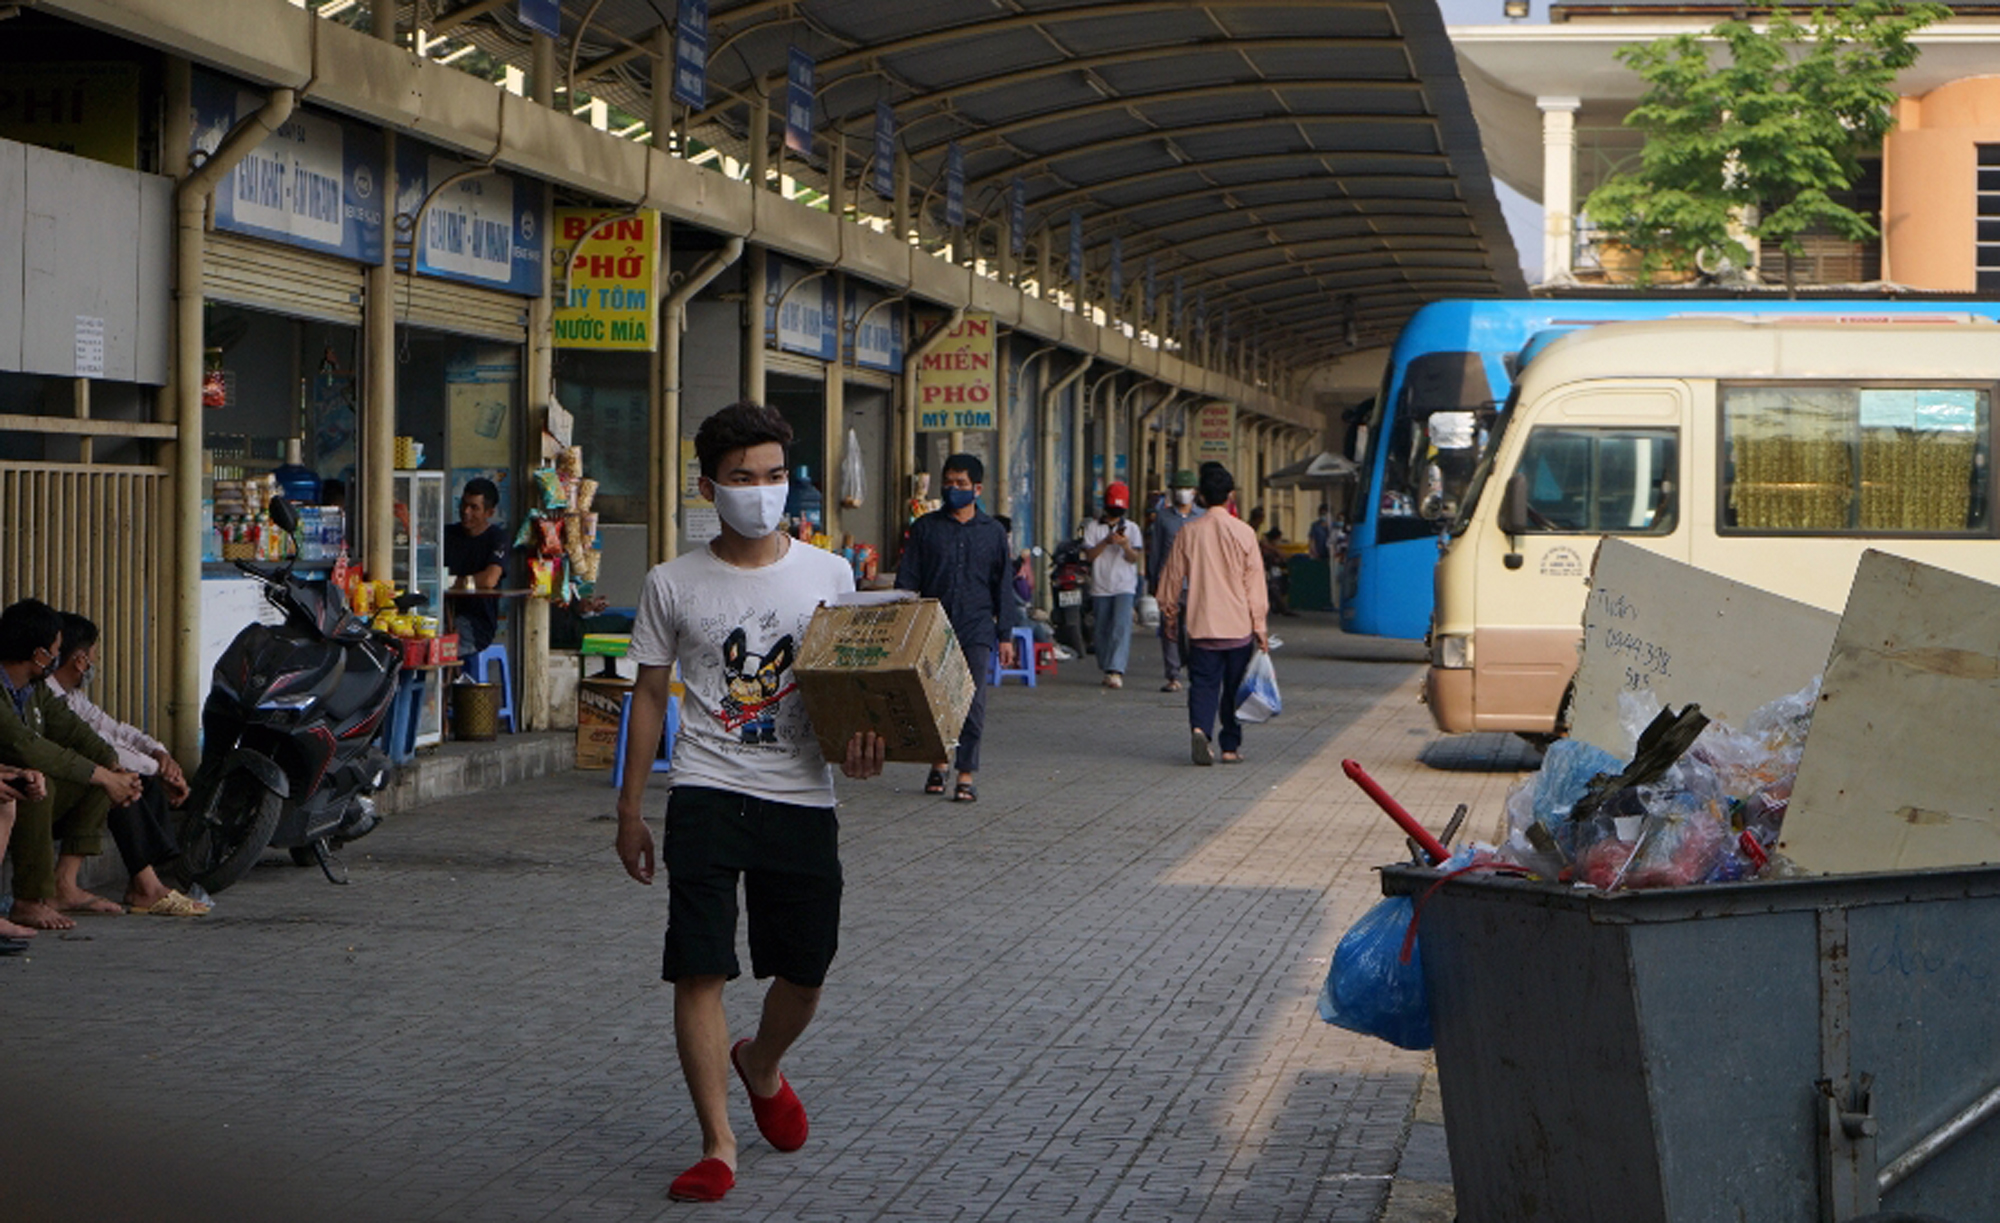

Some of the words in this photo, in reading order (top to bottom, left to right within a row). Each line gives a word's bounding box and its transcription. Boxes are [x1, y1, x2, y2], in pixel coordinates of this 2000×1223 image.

[571, 246, 645, 279] PHỞ
[598, 284, 646, 311] TÔM
[555, 313, 605, 340] NƯỚC
[610, 317, 646, 342] MÍA
[922, 344, 990, 371] MIẾN
[922, 378, 991, 404] PHỞ
[954, 409, 991, 428] TÔM
